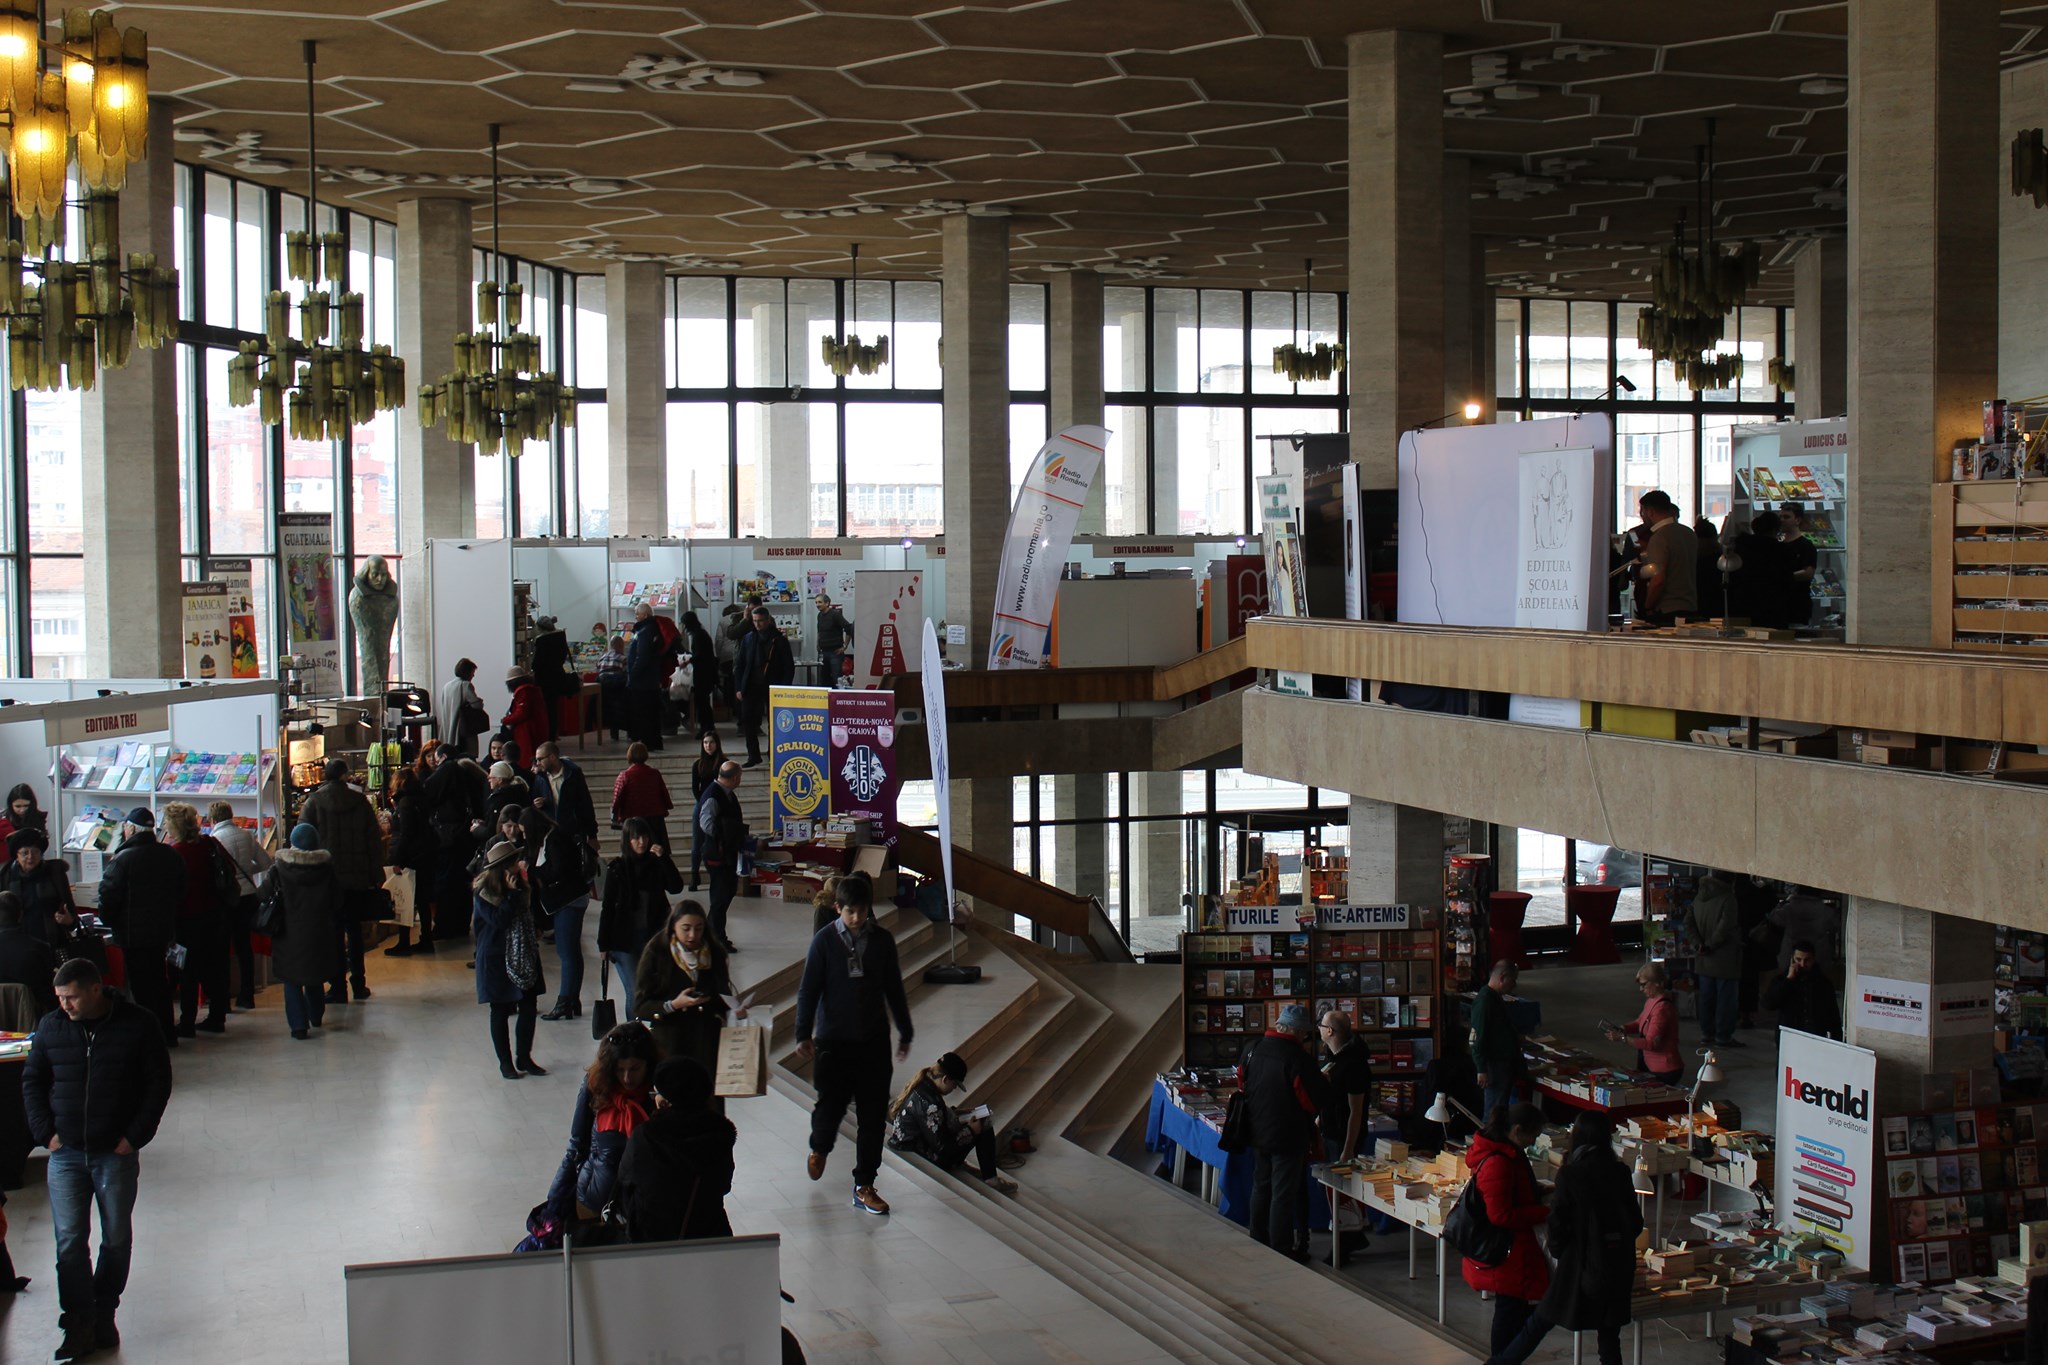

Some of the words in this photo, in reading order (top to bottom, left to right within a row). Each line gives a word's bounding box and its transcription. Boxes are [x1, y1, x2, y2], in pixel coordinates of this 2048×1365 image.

[1804, 434, 1834, 448] LUDICUS
[1062, 468, 1081, 479] Radio
[284, 533, 330, 546] GUATEMALA
[767, 548, 784, 556] AIUS
[785, 548, 804, 556] GRUP
[806, 548, 842, 556] EDITORIAL
[1113, 546, 1141, 554] EDITURA
[1142, 545, 1174, 554] CARMINIS
[1015, 504, 1048, 612] www.radioromania.ro
[1527, 560, 1571, 572] EDITURA
[1529, 579, 1568, 593] ȘCOALA
[188, 600, 221, 610] JAMAICA
[1518, 595, 1579, 610] ARDELEANĂ
[85, 716, 119, 733] EDITURA
[120, 713, 137, 728] TREI
[798, 714, 825, 723] LIONS
[800, 723, 823, 732] CLUB
[848, 727, 876, 735] CRAIOVA
[776, 742, 825, 756] CRAIOVA
[788, 761, 813, 772] LIONS
[860, 750, 868, 794] LEO
[1785, 1066, 1868, 1121] herald
[1827, 1115, 1842, 1126] grup
[1843, 1117, 1868, 1135] editorial
[1803, 1142, 1817, 1152] Istoria
[1817, 1145, 1835, 1158] religiilor
[1819, 1162, 1848, 1178] fundamentale
[1819, 1181, 1837, 1192] Filosofie
[1815, 1210, 1837, 1226] spirituale
